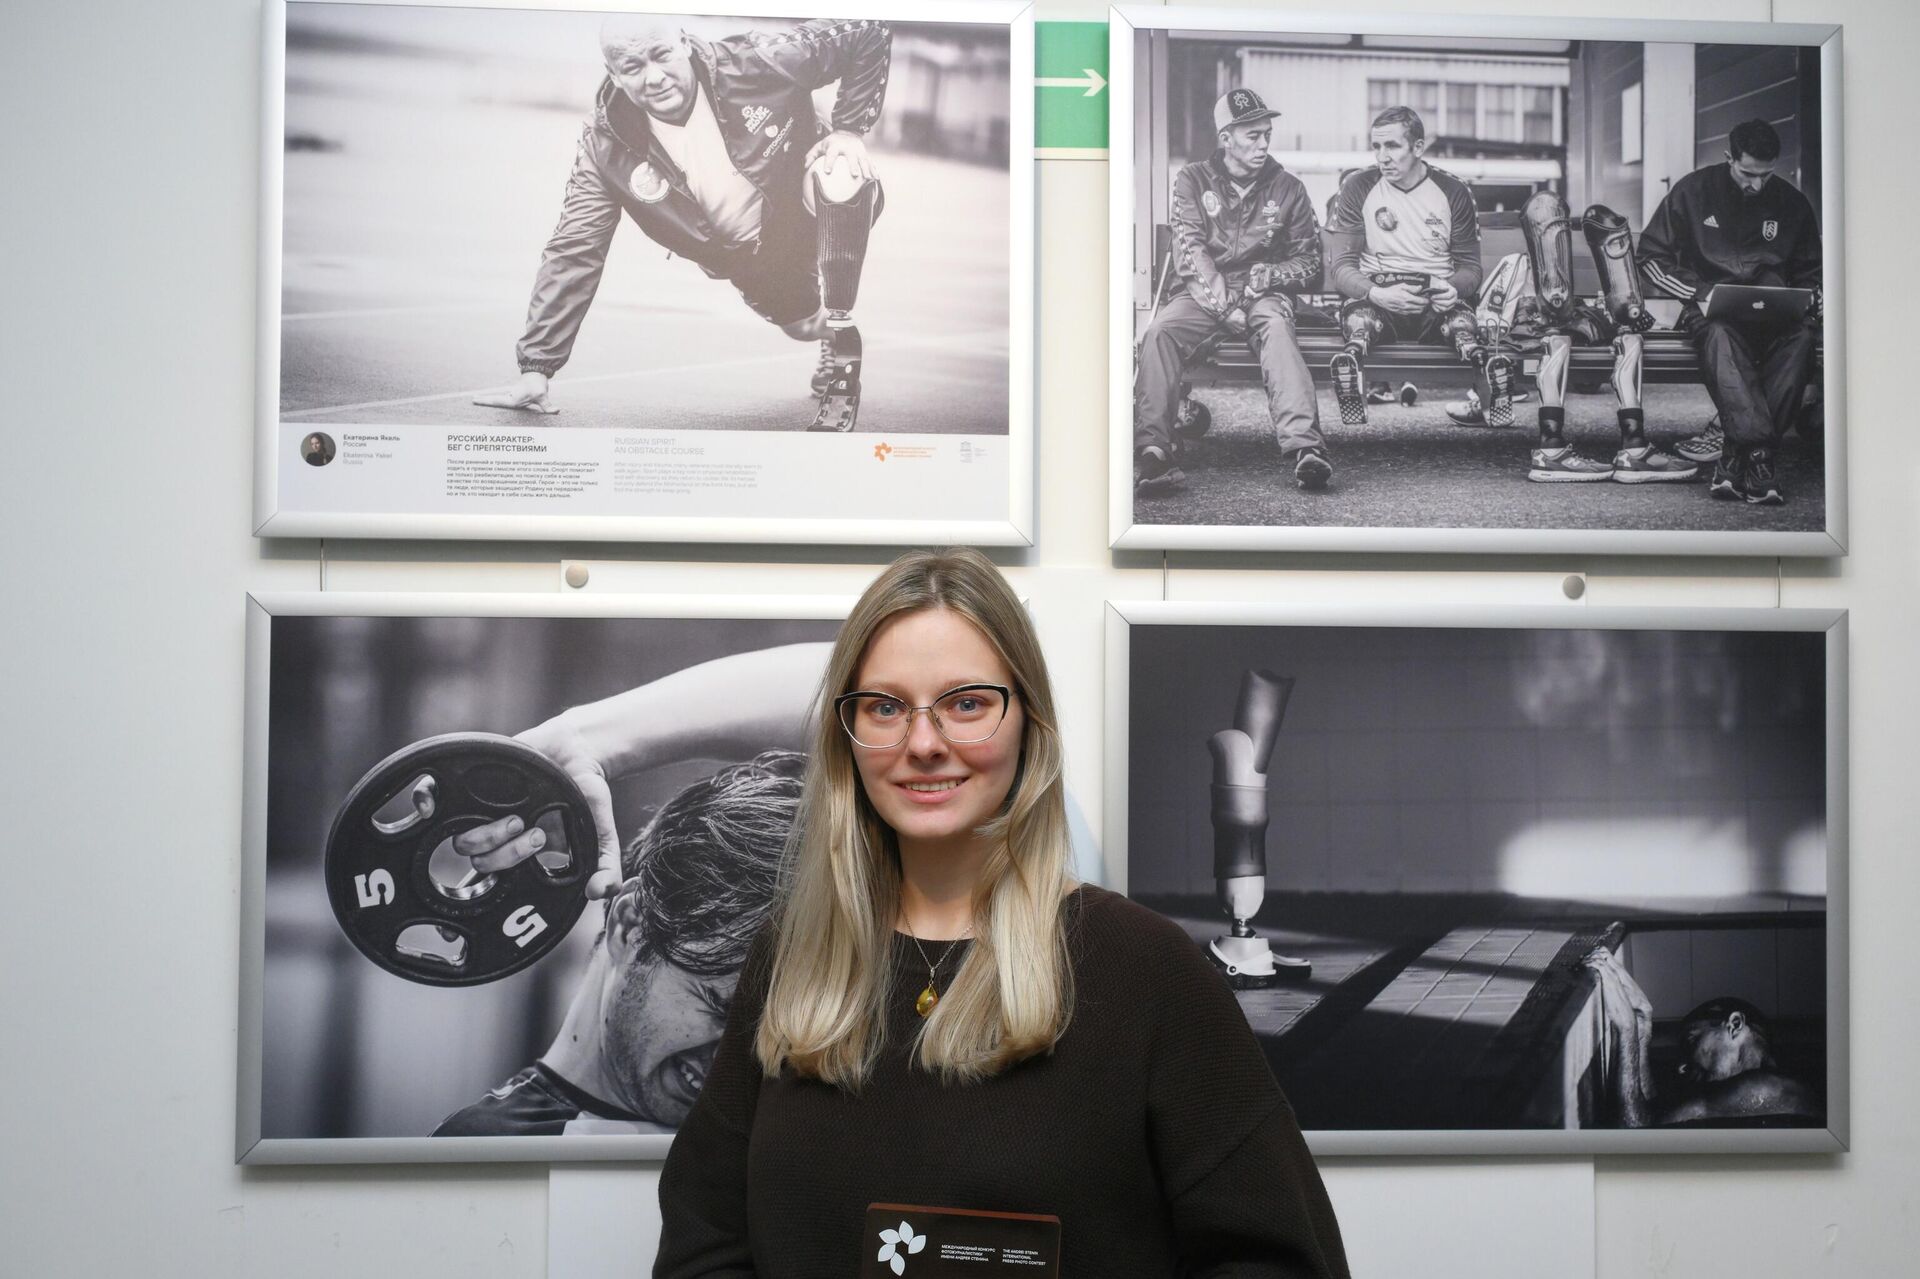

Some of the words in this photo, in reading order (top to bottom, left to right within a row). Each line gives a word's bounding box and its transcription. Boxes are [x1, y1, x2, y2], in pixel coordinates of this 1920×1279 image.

[473, 444, 547, 453] ПРЕПЯТСТВИЯМИ
[490, 435, 535, 443] ХАРАКТЕР:
[354, 868, 395, 908] 5
[502, 904, 548, 948] 5
